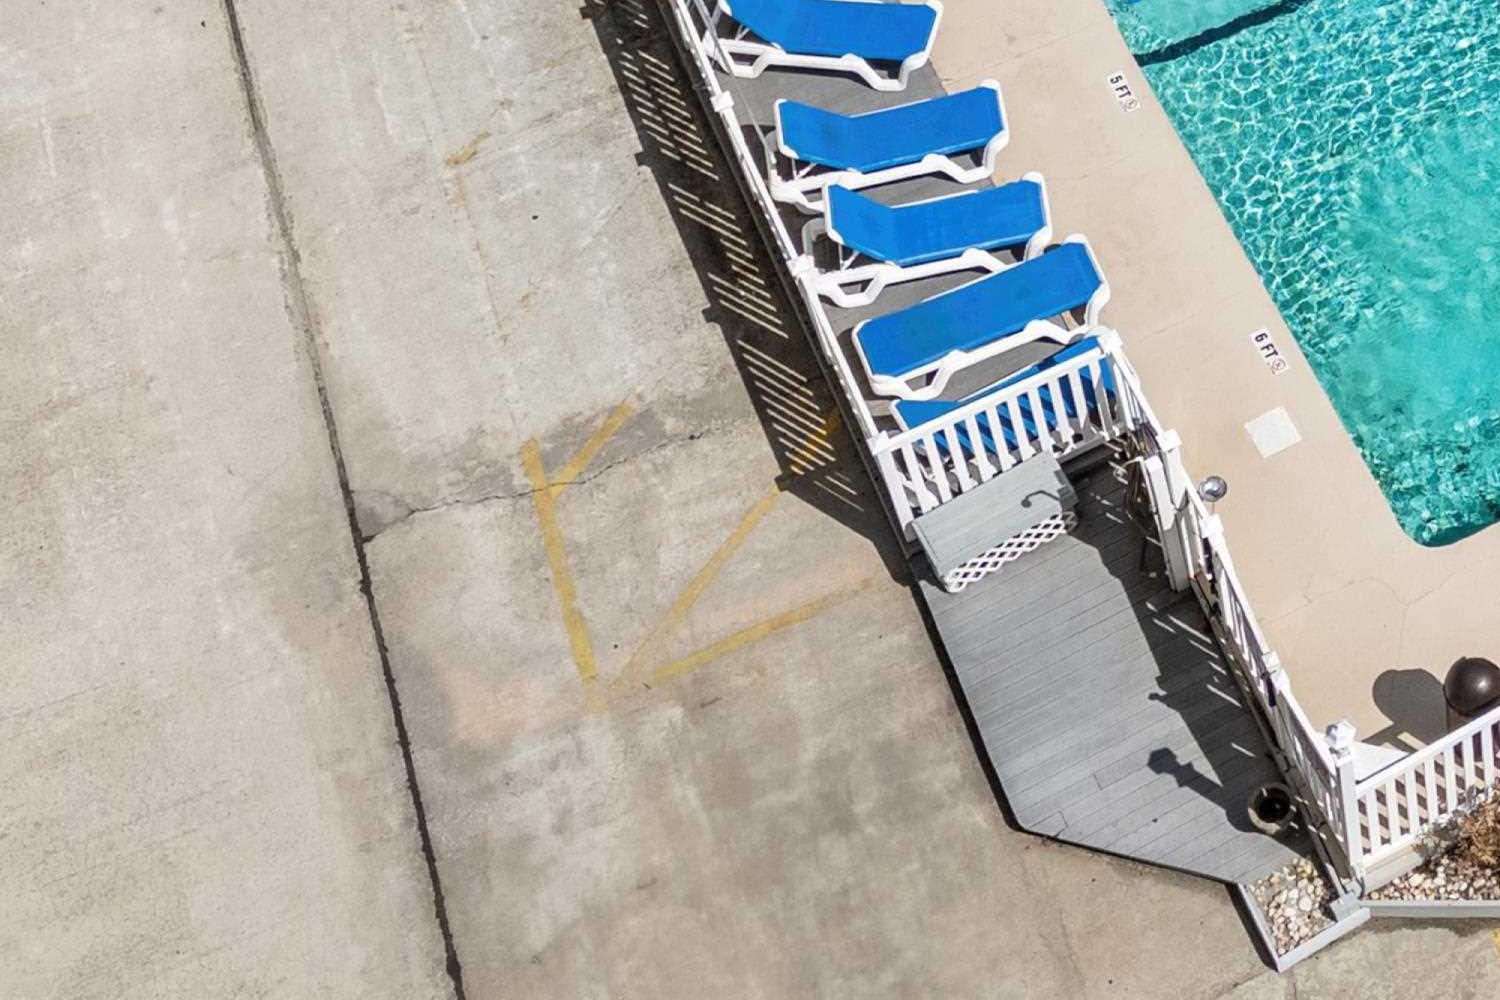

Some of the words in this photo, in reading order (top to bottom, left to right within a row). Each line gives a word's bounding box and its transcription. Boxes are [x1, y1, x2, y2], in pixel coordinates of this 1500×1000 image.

[1110, 75, 1123, 84] 5
[1115, 85, 1131, 98] FT
[1255, 332, 1268, 342] 6
[1261, 343, 1278, 358] FT
